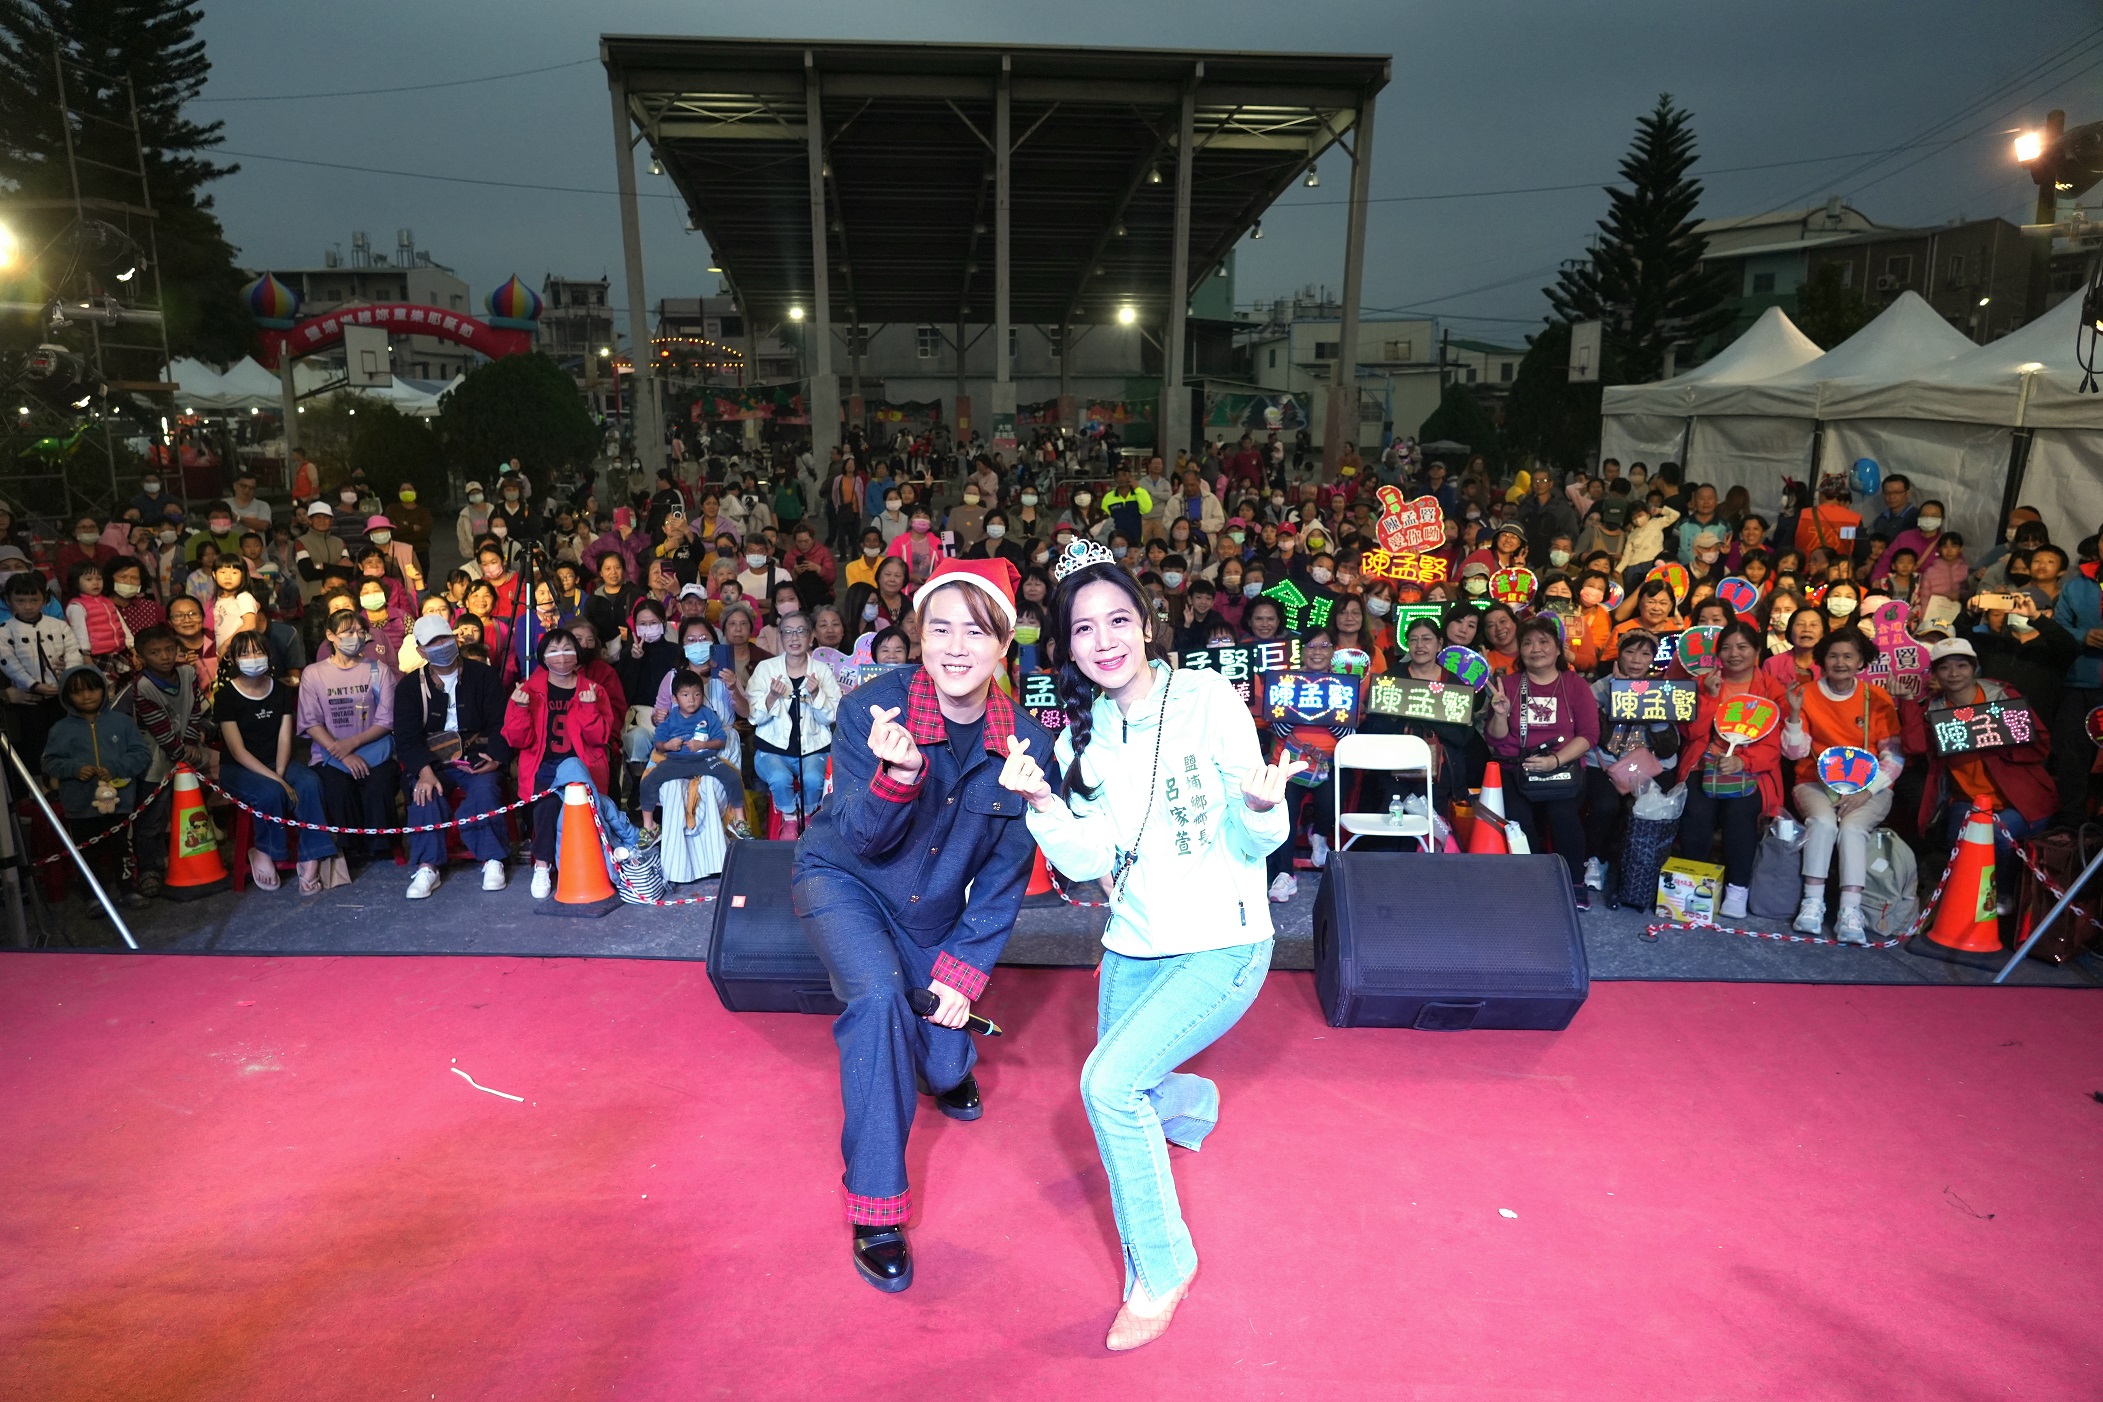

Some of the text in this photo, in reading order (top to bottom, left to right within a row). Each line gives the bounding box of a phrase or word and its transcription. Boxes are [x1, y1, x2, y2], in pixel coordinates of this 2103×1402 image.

[1382, 507, 1436, 535] 陳孟賢
[1362, 548, 1447, 583] 陳孟賢
[1496, 573, 1532, 594] 孟賢
[350, 684, 369, 694] STOP
[1025, 676, 1057, 707] 孟
[1269, 682, 1354, 711] 陳孟賢
[1371, 685, 1470, 722] 陳孟賢
[1611, 689, 1696, 721] 陳孟賢
[1723, 701, 1774, 728] 孟賢
[550, 714, 572, 754] 9
[1935, 709, 2031, 752] 陳孟賢
[1166, 777, 1191, 856] 呂家萱
